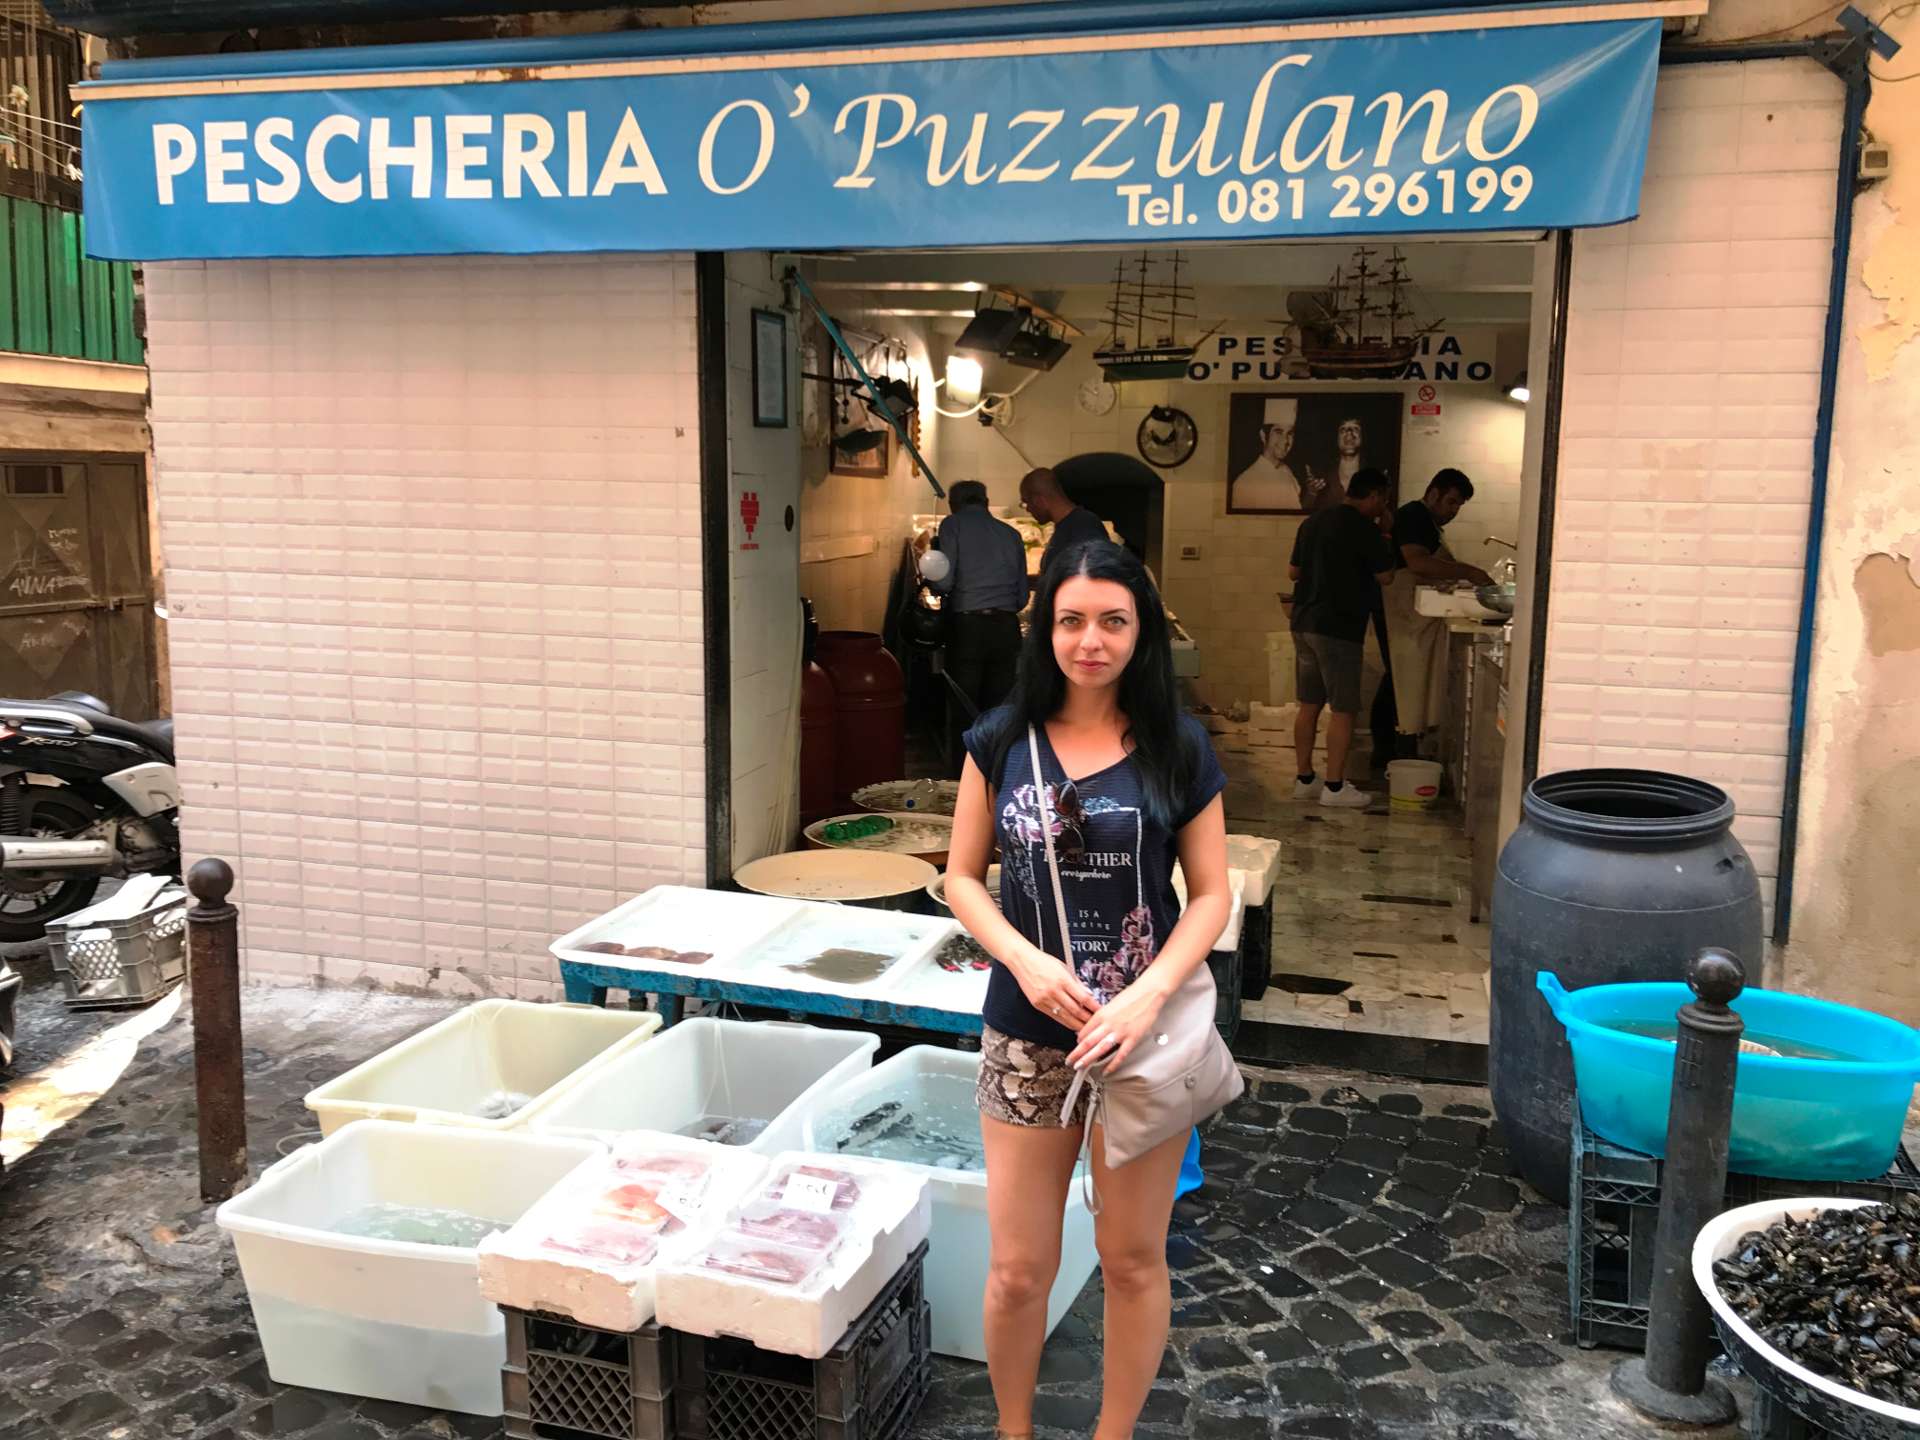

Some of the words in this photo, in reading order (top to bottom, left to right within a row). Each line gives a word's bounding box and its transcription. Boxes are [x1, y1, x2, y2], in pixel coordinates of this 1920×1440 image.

[153, 106, 668, 205] PESCHERIA
[698, 84, 810, 197] O'
[833, 54, 1539, 188] Puzzulano
[1116, 183, 1198, 226] Tel.
[1217, 178, 1305, 224] 081
[1329, 165, 1533, 218] 296199
[1218, 335, 1462, 356] PESIA
[1040, 849, 1133, 867] THER
[1079, 909, 1089, 918] IS
[1093, 910, 1100, 918] A
[1070, 940, 1111, 952] STORY
